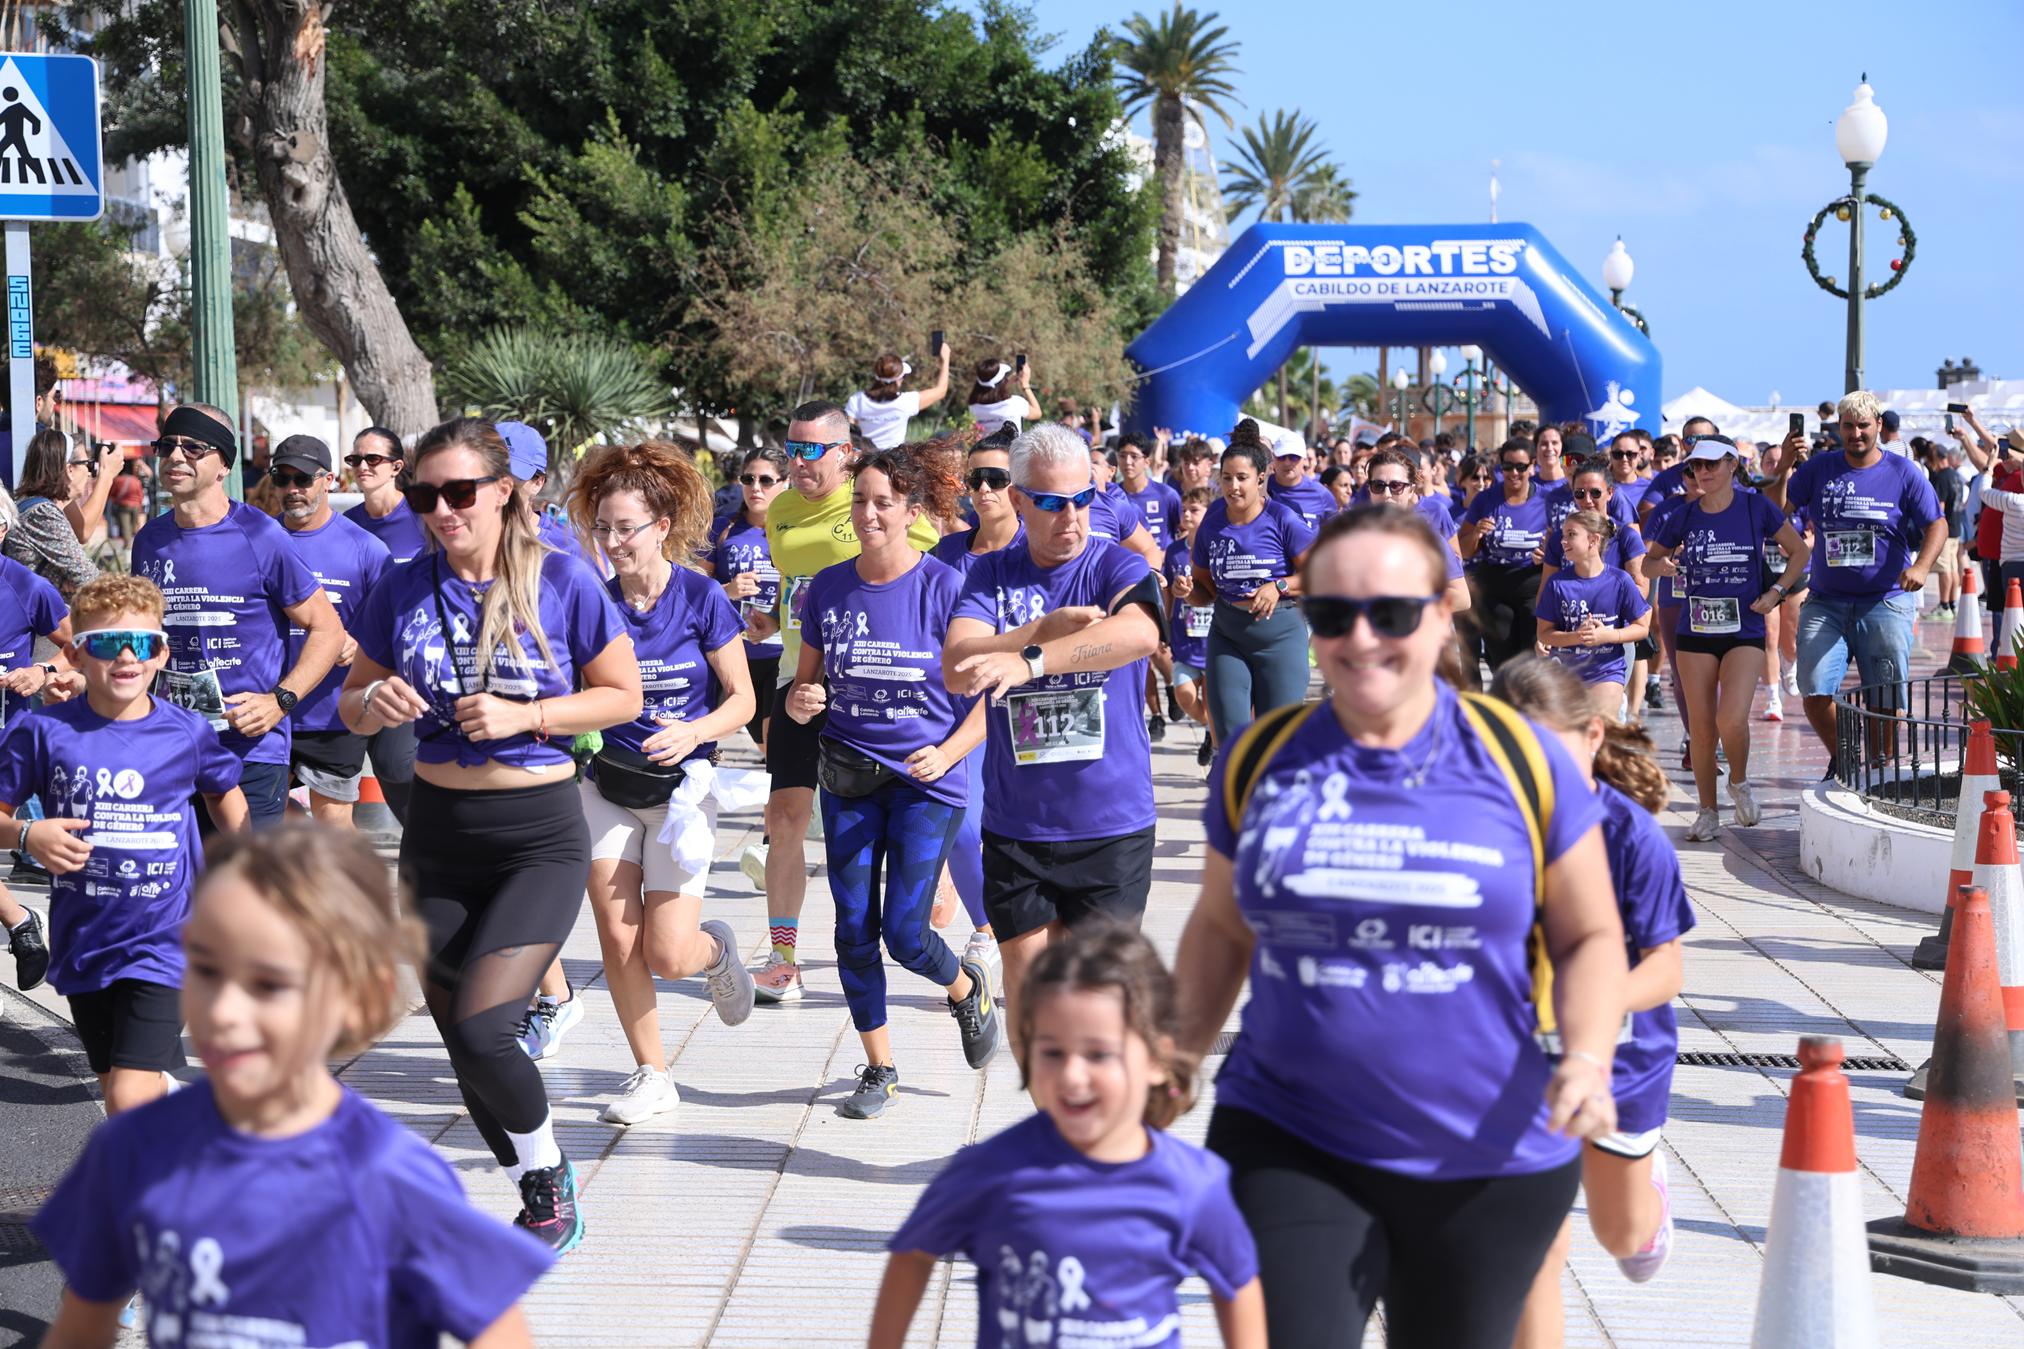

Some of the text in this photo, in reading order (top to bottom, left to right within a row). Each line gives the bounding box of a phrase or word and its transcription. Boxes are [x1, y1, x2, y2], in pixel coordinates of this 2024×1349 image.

[1284, 245, 1517, 275] DEPORTES
[1295, 282, 1508, 294] CABILDO DE LANZAROTE
[1840, 543, 1860, 554] 112
[200, 595, 244, 603] VIOLENCIA
[173, 602, 200, 610] GÉNERO
[1193, 615, 1213, 626] 112
[1702, 610, 1726, 622] 016
[206, 638, 222, 649] ICI
[867, 641, 900, 650] CARRERA
[892, 650, 934, 658] VIOLENCIA
[1070, 642, 1112, 664] Triana
[500, 657, 550, 670] VIOLNCIA
[862, 655, 892, 664] GÉNERO
[657, 661, 696, 672] VIOLENCIA
[1074, 672, 1090, 686] ICI
[898, 689, 912, 698] ICI
[167, 692, 196, 711] 112
[664, 696, 676, 706] ICI
[1033, 714, 1078, 738] 112
[94, 802, 154, 813] XIII CARRERA
[94, 812, 132, 821] CONTRA
[132, 813, 145, 822] LA
[93, 820, 144, 832] DE GÉNERO
[147, 862, 164, 876] ICI
